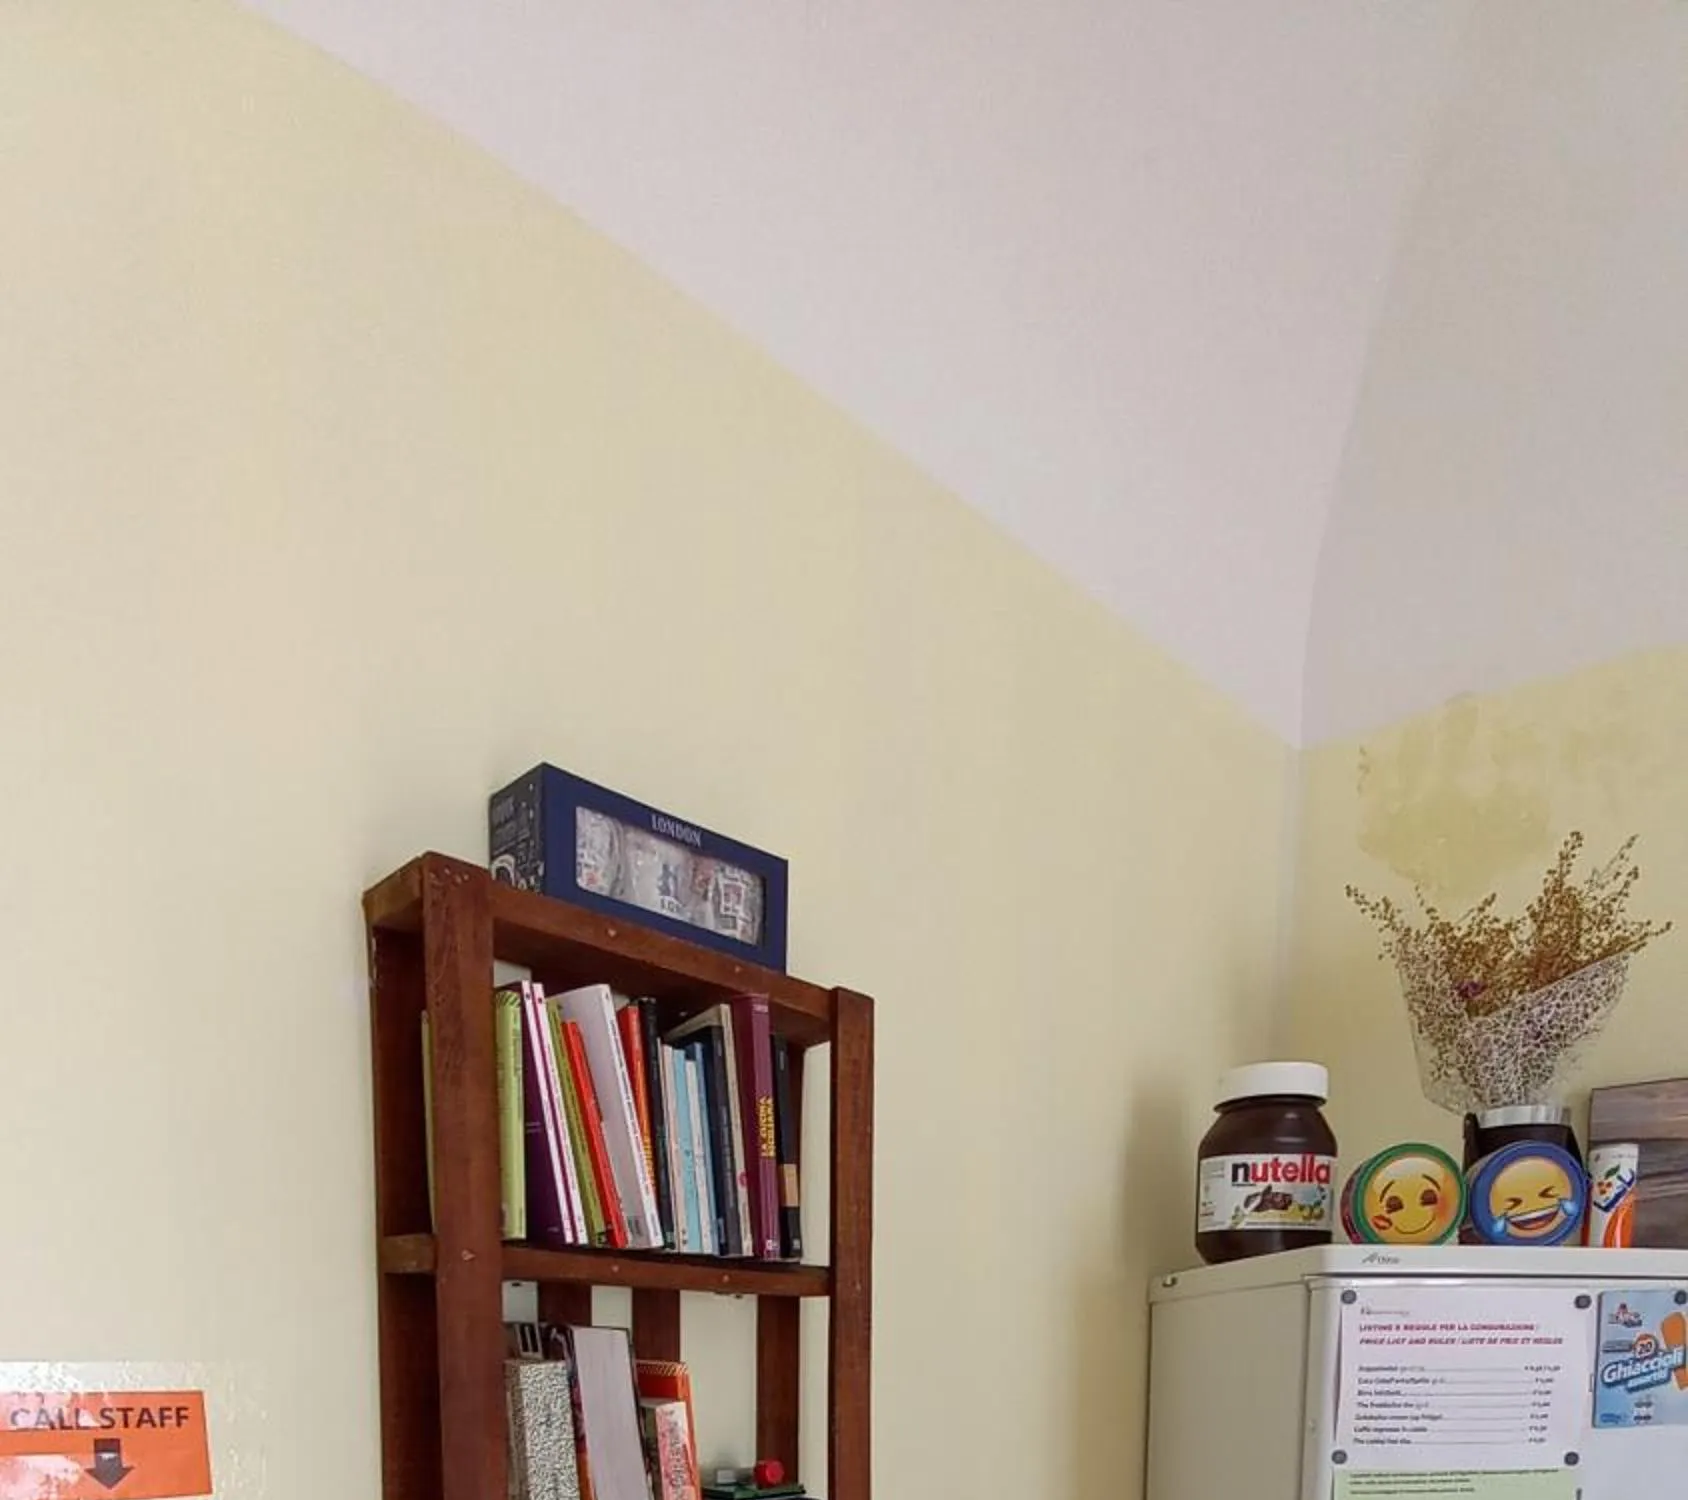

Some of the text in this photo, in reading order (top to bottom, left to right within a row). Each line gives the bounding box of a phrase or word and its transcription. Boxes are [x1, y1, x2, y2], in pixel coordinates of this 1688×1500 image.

[651, 813, 701, 847] LONDON
[1231, 1152, 1330, 1184] nutella
[10, 1406, 189, 1431] CALL STAFF
